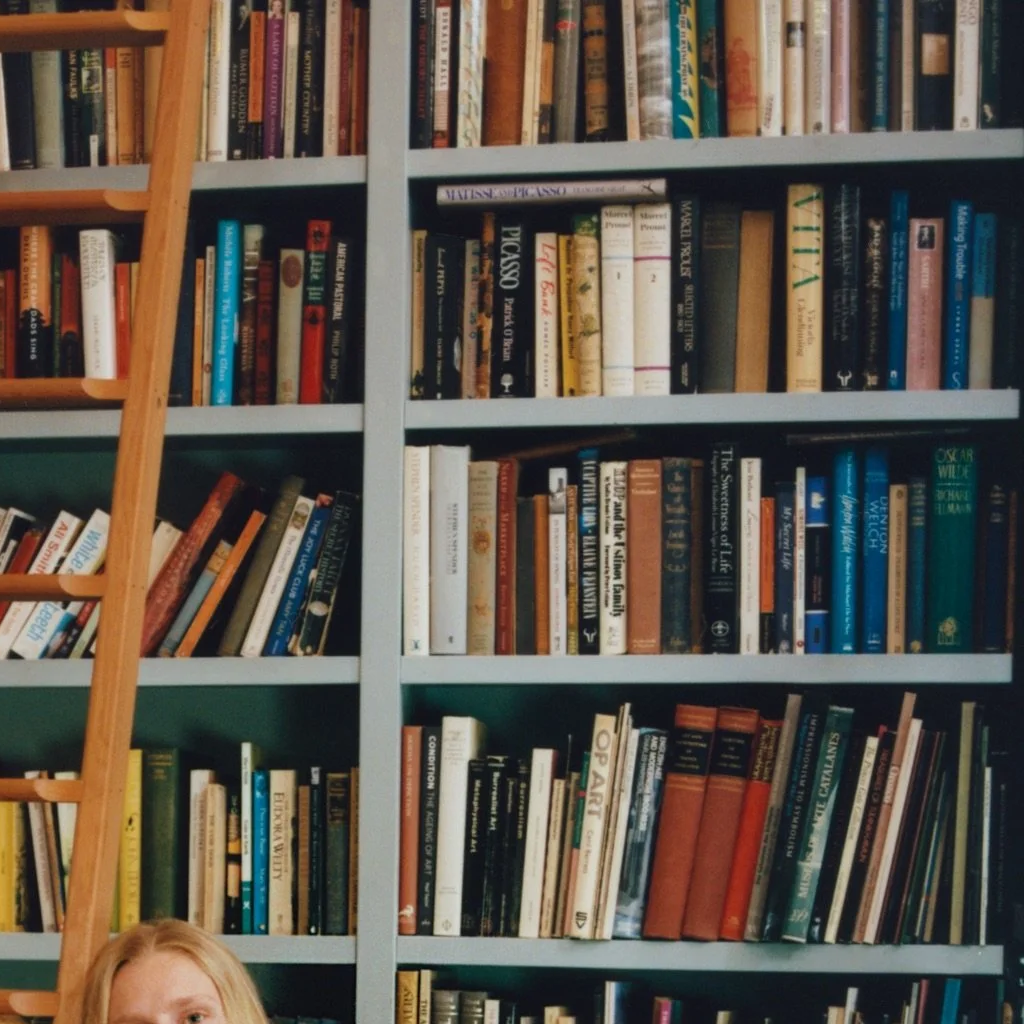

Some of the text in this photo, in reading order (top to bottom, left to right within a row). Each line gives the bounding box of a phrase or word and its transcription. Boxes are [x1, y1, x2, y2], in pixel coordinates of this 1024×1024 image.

[237, 49, 248, 134] RUMER GODDEN
[302, 90, 311, 136] COUNTRY
[445, 186, 567, 201] MATISSE PICASSO
[680, 200, 693, 240] MARCEL
[335, 242, 347, 282] AMERICAN
[499, 226, 521, 290] PICASSO
[953, 205, 967, 280] Making Trouble
[436, 270, 445, 296] PEPYS
[792, 191, 821, 346] VITA Victoria
[331, 283, 345, 320] PASTORAL
[503, 297, 515, 328] Patrick
[29, 337, 38, 360] SING
[795, 298, 807, 357] Glendinning
[934, 447, 974, 465] OSCAR
[937, 464, 971, 480] WILDE
[57, 521, 70, 539] Ali
[310, 519, 322, 536] THE
[719, 447, 733, 574] The Sweetness of Life
[869, 500, 879, 549] WELCH
[70, 529, 103, 569] white
[303, 537, 316, 553] JOY
[608, 501, 625, 618] and the family
[781, 506, 793, 570] My Secret Life
[288, 576, 303, 599] CLUB
[649, 735, 658, 750] AND
[586, 729, 610, 820] OP ART
[786, 713, 819, 858] IMPRESSIONISM TO SYMBOLISM
[817, 732, 841, 798] CATALANES
[423, 735, 437, 876] CONDITION THE AGEING OF ART
[469, 779, 482, 853] Metaphysical Art
[488, 813, 497, 831] Art
[271, 792, 285, 881] EUDORA WELTY
